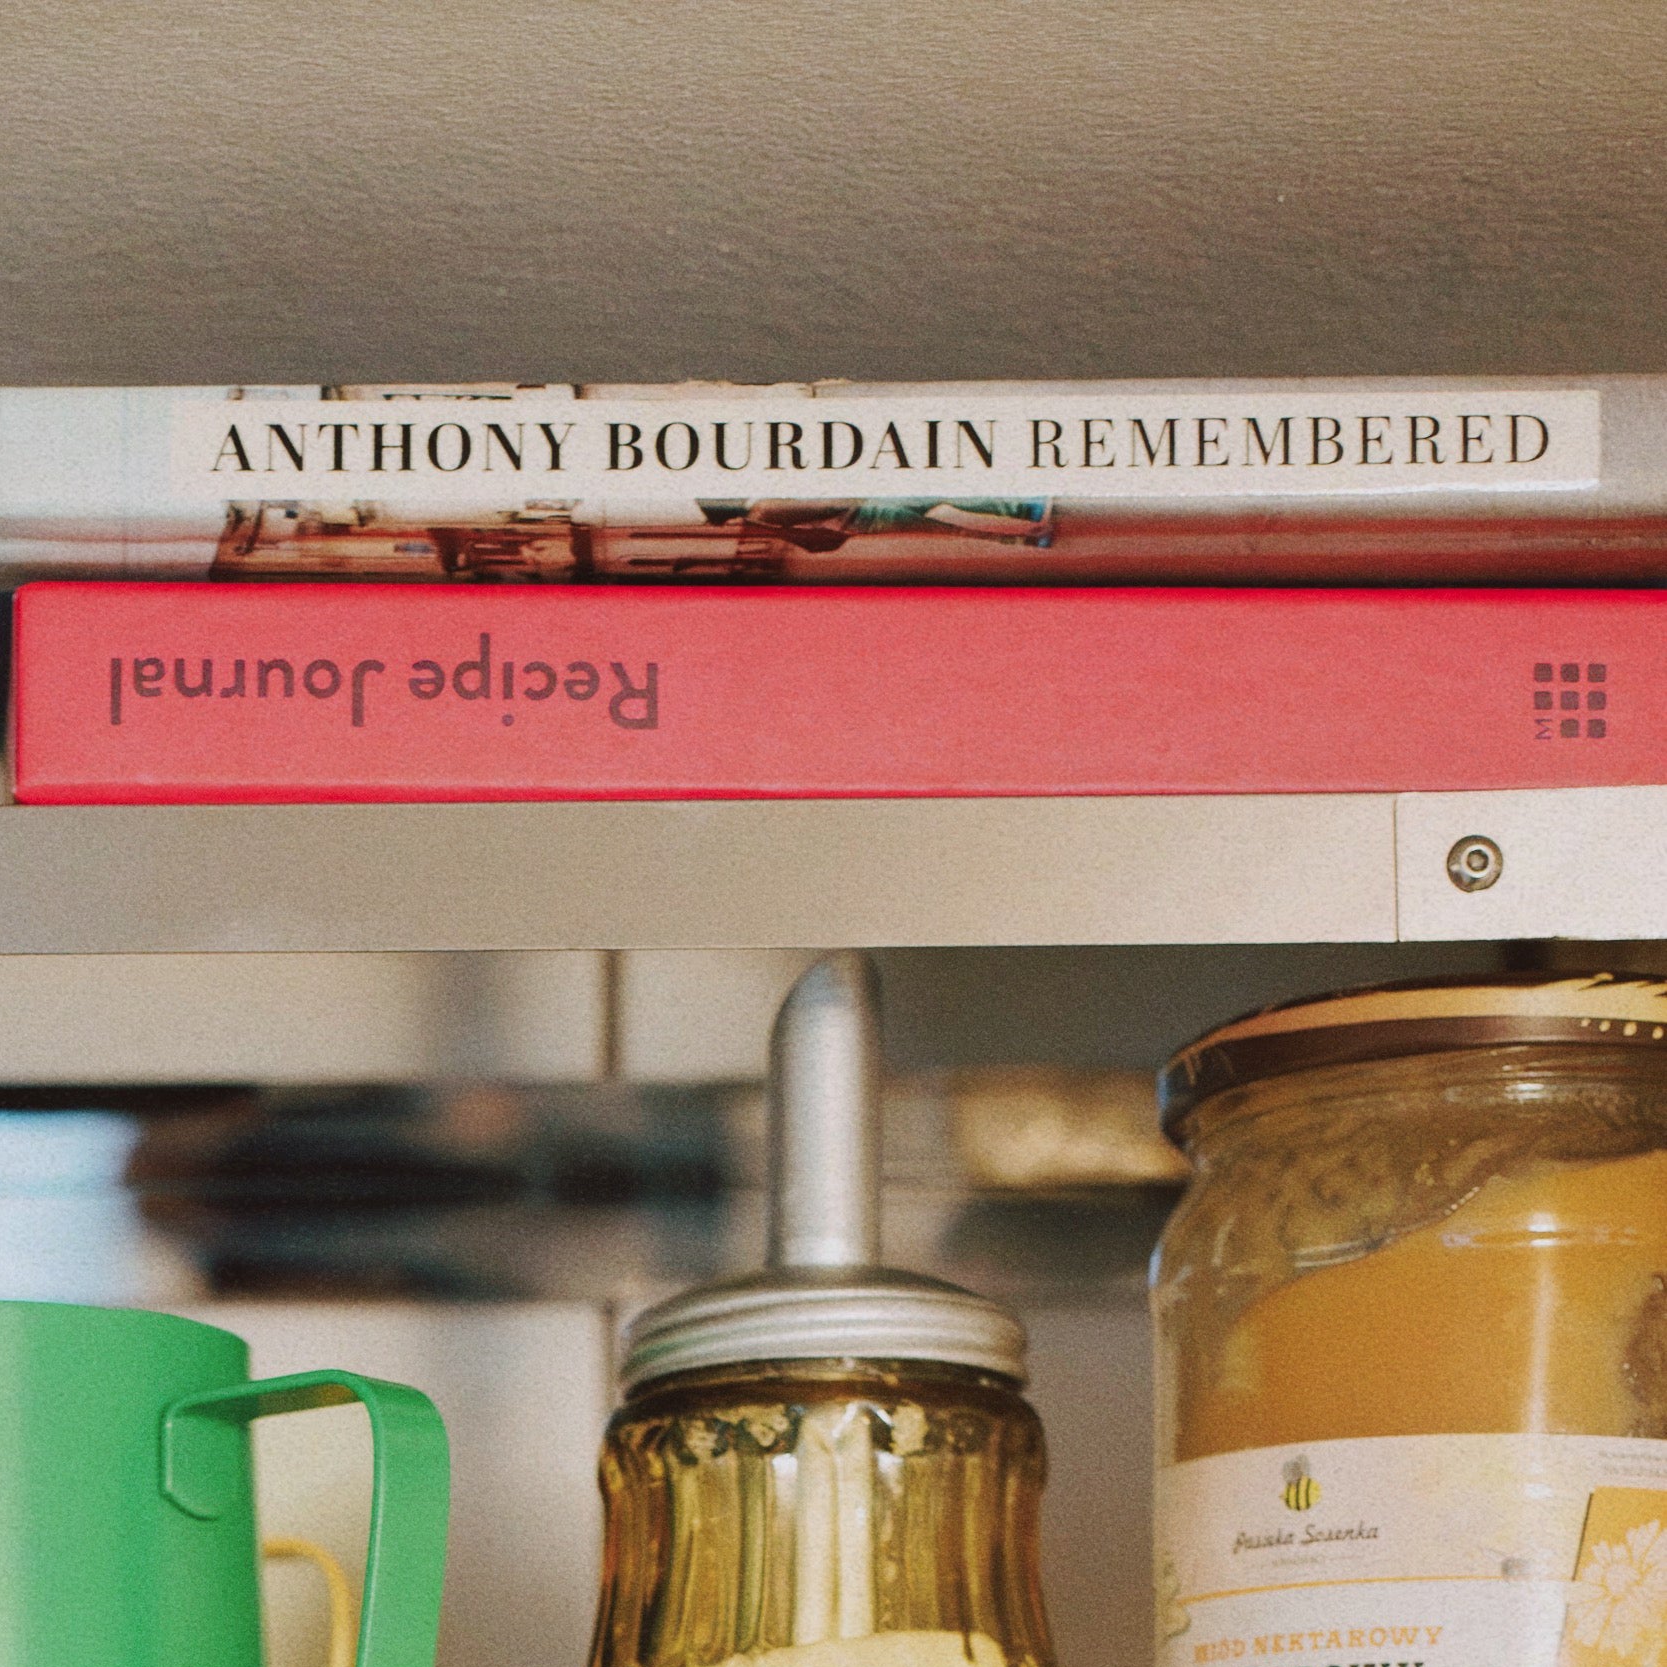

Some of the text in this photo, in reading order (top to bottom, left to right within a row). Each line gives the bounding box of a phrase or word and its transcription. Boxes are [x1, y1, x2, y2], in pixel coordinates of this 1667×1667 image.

[211, 411, 1551, 473] ANTHONY BOURDAIN REMEMBERED
[110, 632, 660, 731] Recipe Journal
[1251, 1625, 1444, 1656] NEKTAROWY
